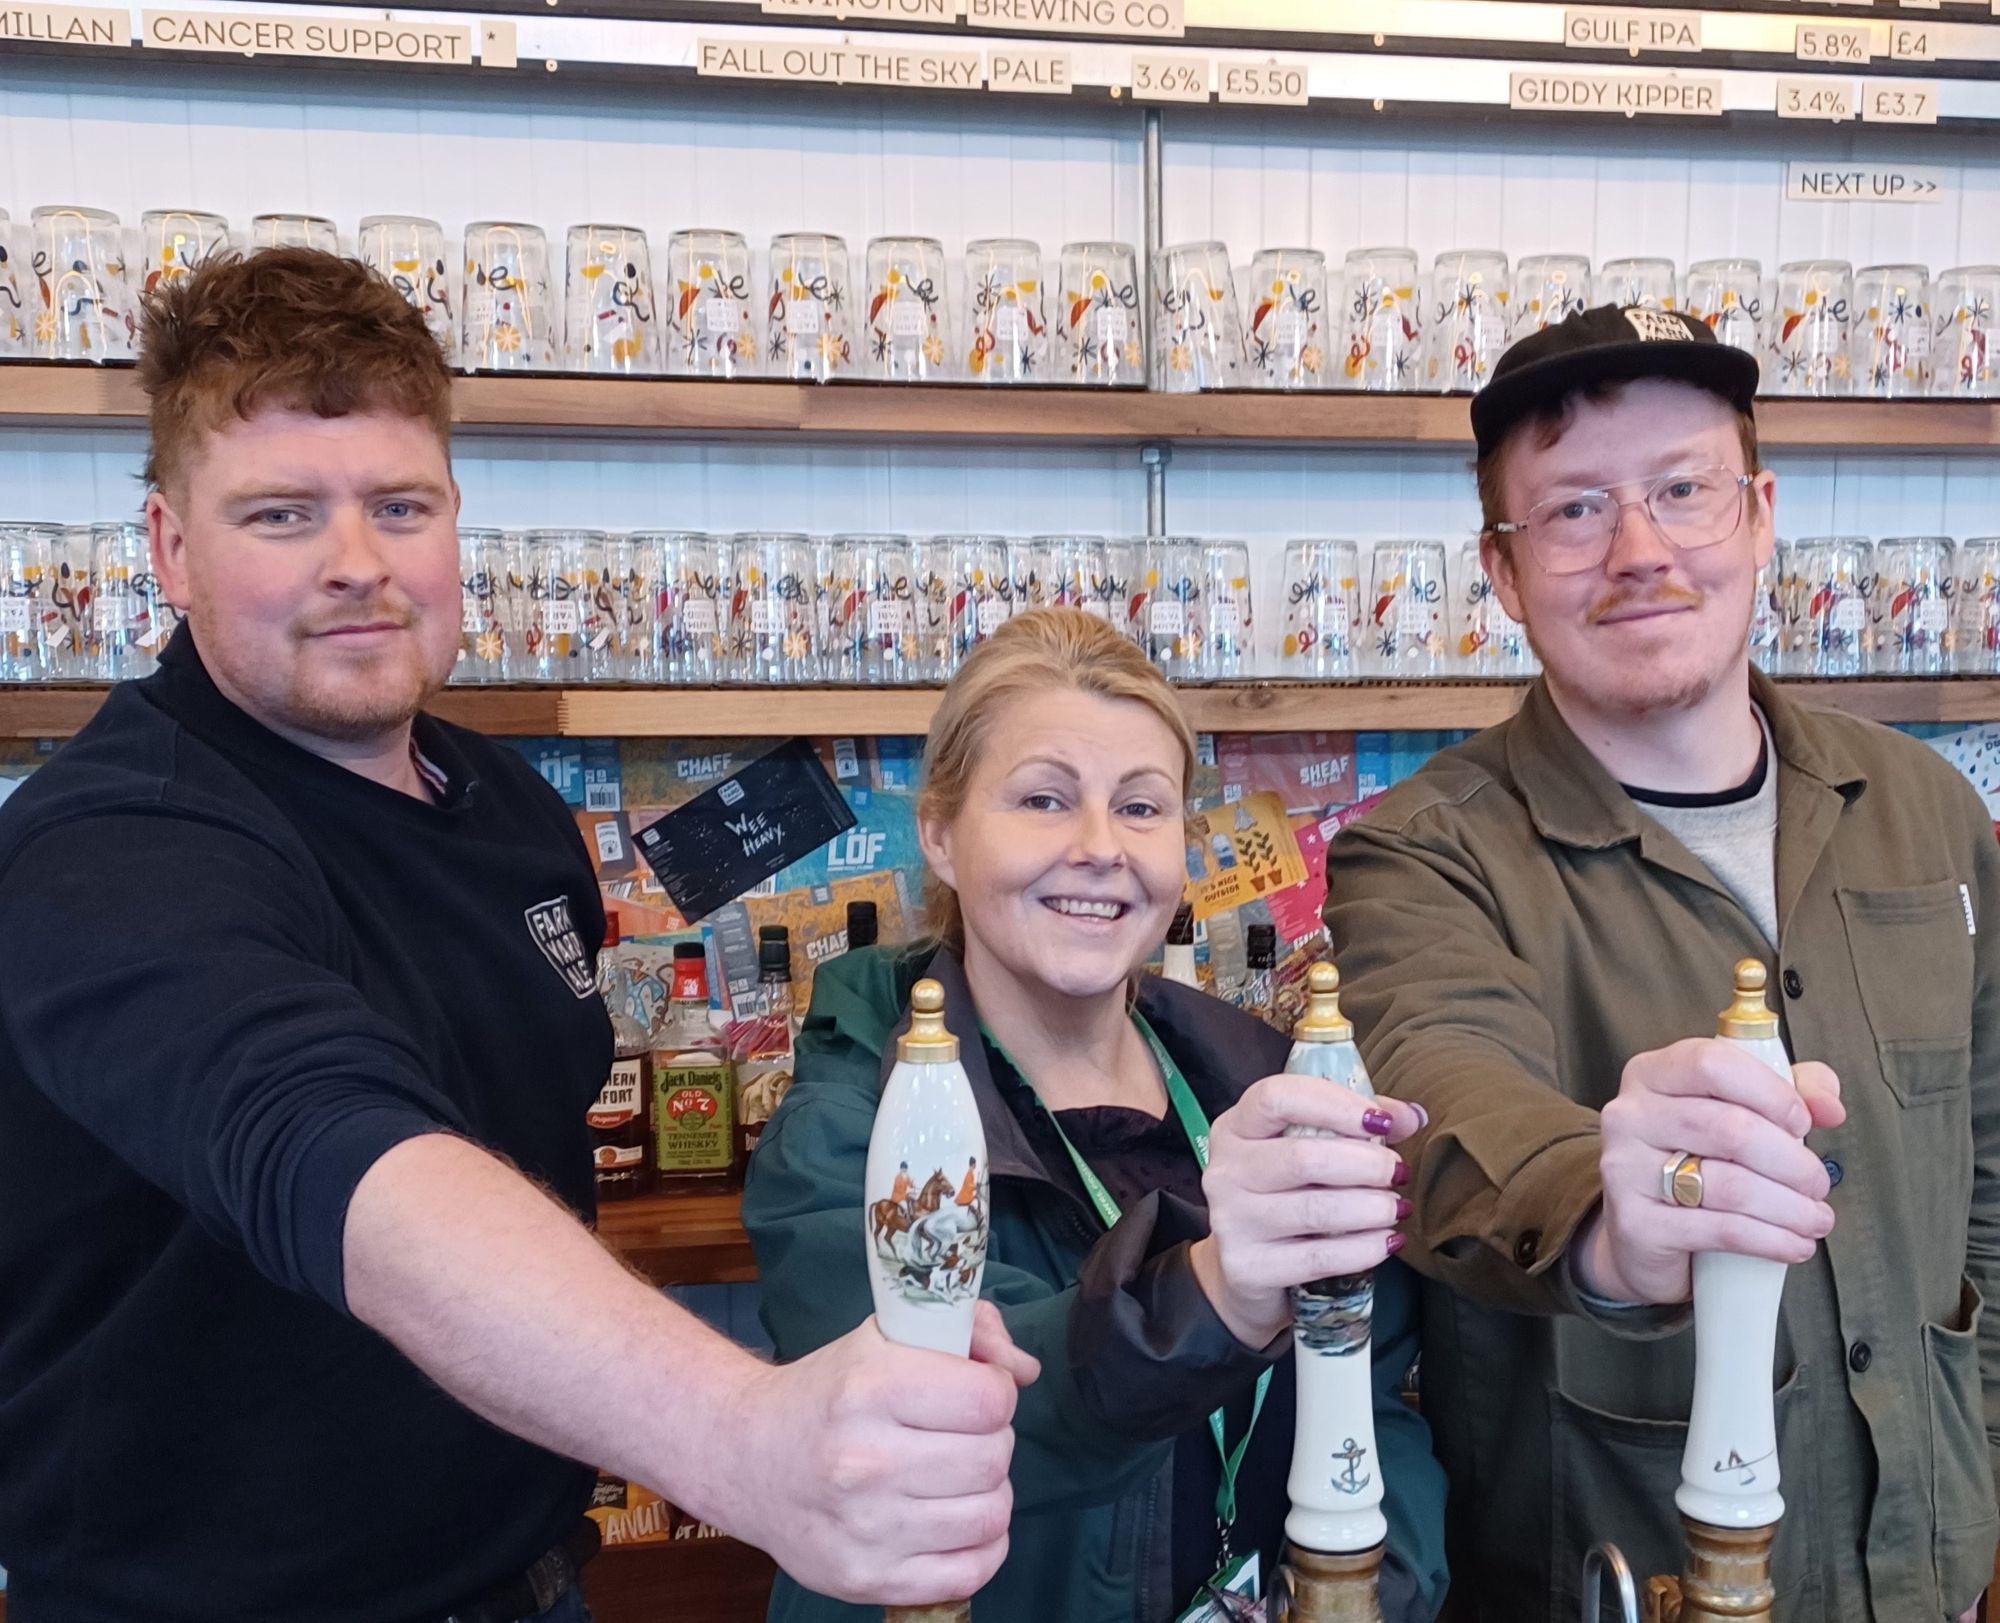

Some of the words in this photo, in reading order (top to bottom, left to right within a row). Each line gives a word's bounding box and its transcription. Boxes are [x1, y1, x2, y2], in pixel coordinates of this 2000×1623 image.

[973, 0, 1115, 26] BREWING
[1123, 4, 1176, 30] CO.
[152, 16, 295, 50] CANCER
[305, 26, 462, 61] SUPPORT
[1571, 21, 1639, 45] GULF
[1648, 23, 1695, 46] IPA
[1803, 31, 1863, 58] 5.8%
[1898, 32, 1928, 55] £4
[702, 45, 773, 74] FALL
[783, 50, 846, 77] OUT
[855, 54, 910, 82] THE
[920, 59, 977, 84] SKY
[992, 57, 1064, 86] PALE
[1136, 64, 1200, 93] 3.6%
[1227, 67, 1301, 97] £5.50
[1518, 79, 1607, 105] GIDDY
[1617, 83, 1713, 111] KIPPER
[1787, 88, 1846, 115] 3.4%
[1876, 92, 1925, 117] £3.7
[1802, 171, 1864, 195] NEXT
[1872, 174, 1904, 197] UP
[677, 752, 733, 777] CHAFF
[1299, 755, 1349, 784] SHEAF
[724, 812, 767, 836] WEE
[827, 827, 886, 866] LÖF
[668, 1140, 719, 1149] WHISKEY
